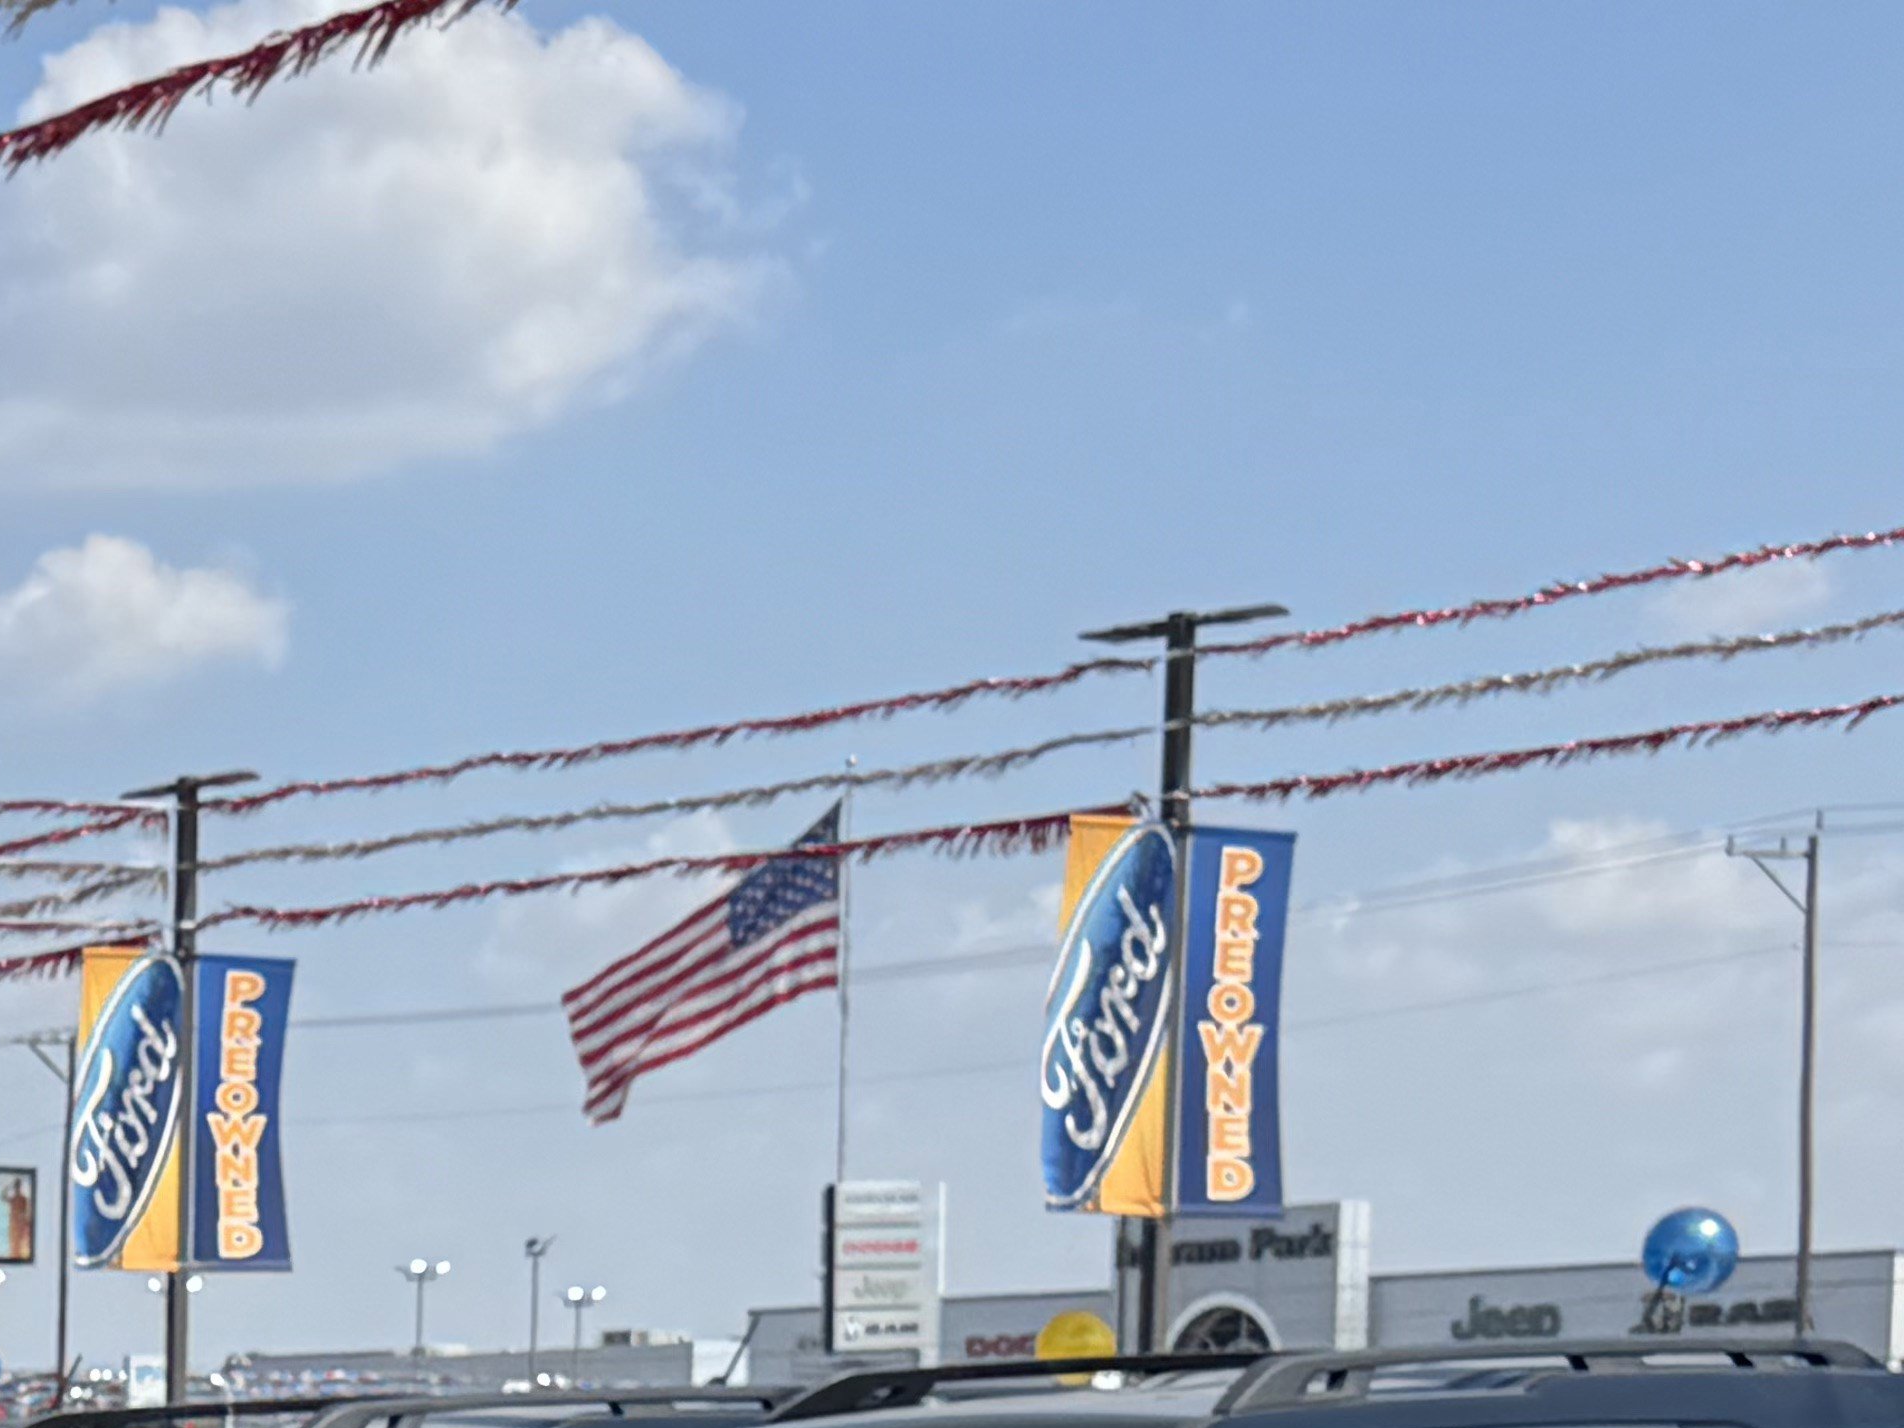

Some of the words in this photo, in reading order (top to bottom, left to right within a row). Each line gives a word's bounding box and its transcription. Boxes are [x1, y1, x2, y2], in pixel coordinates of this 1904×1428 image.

[72, 1002, 177, 1219] Ford
[206, 970, 267, 1258] PREOWNED
[1040, 883, 1167, 1150] Ford
[1198, 846, 1264, 1202] PREOWNED
[1249, 1223, 1333, 1260] Park
[1451, 1294, 1562, 1340] Jeep
